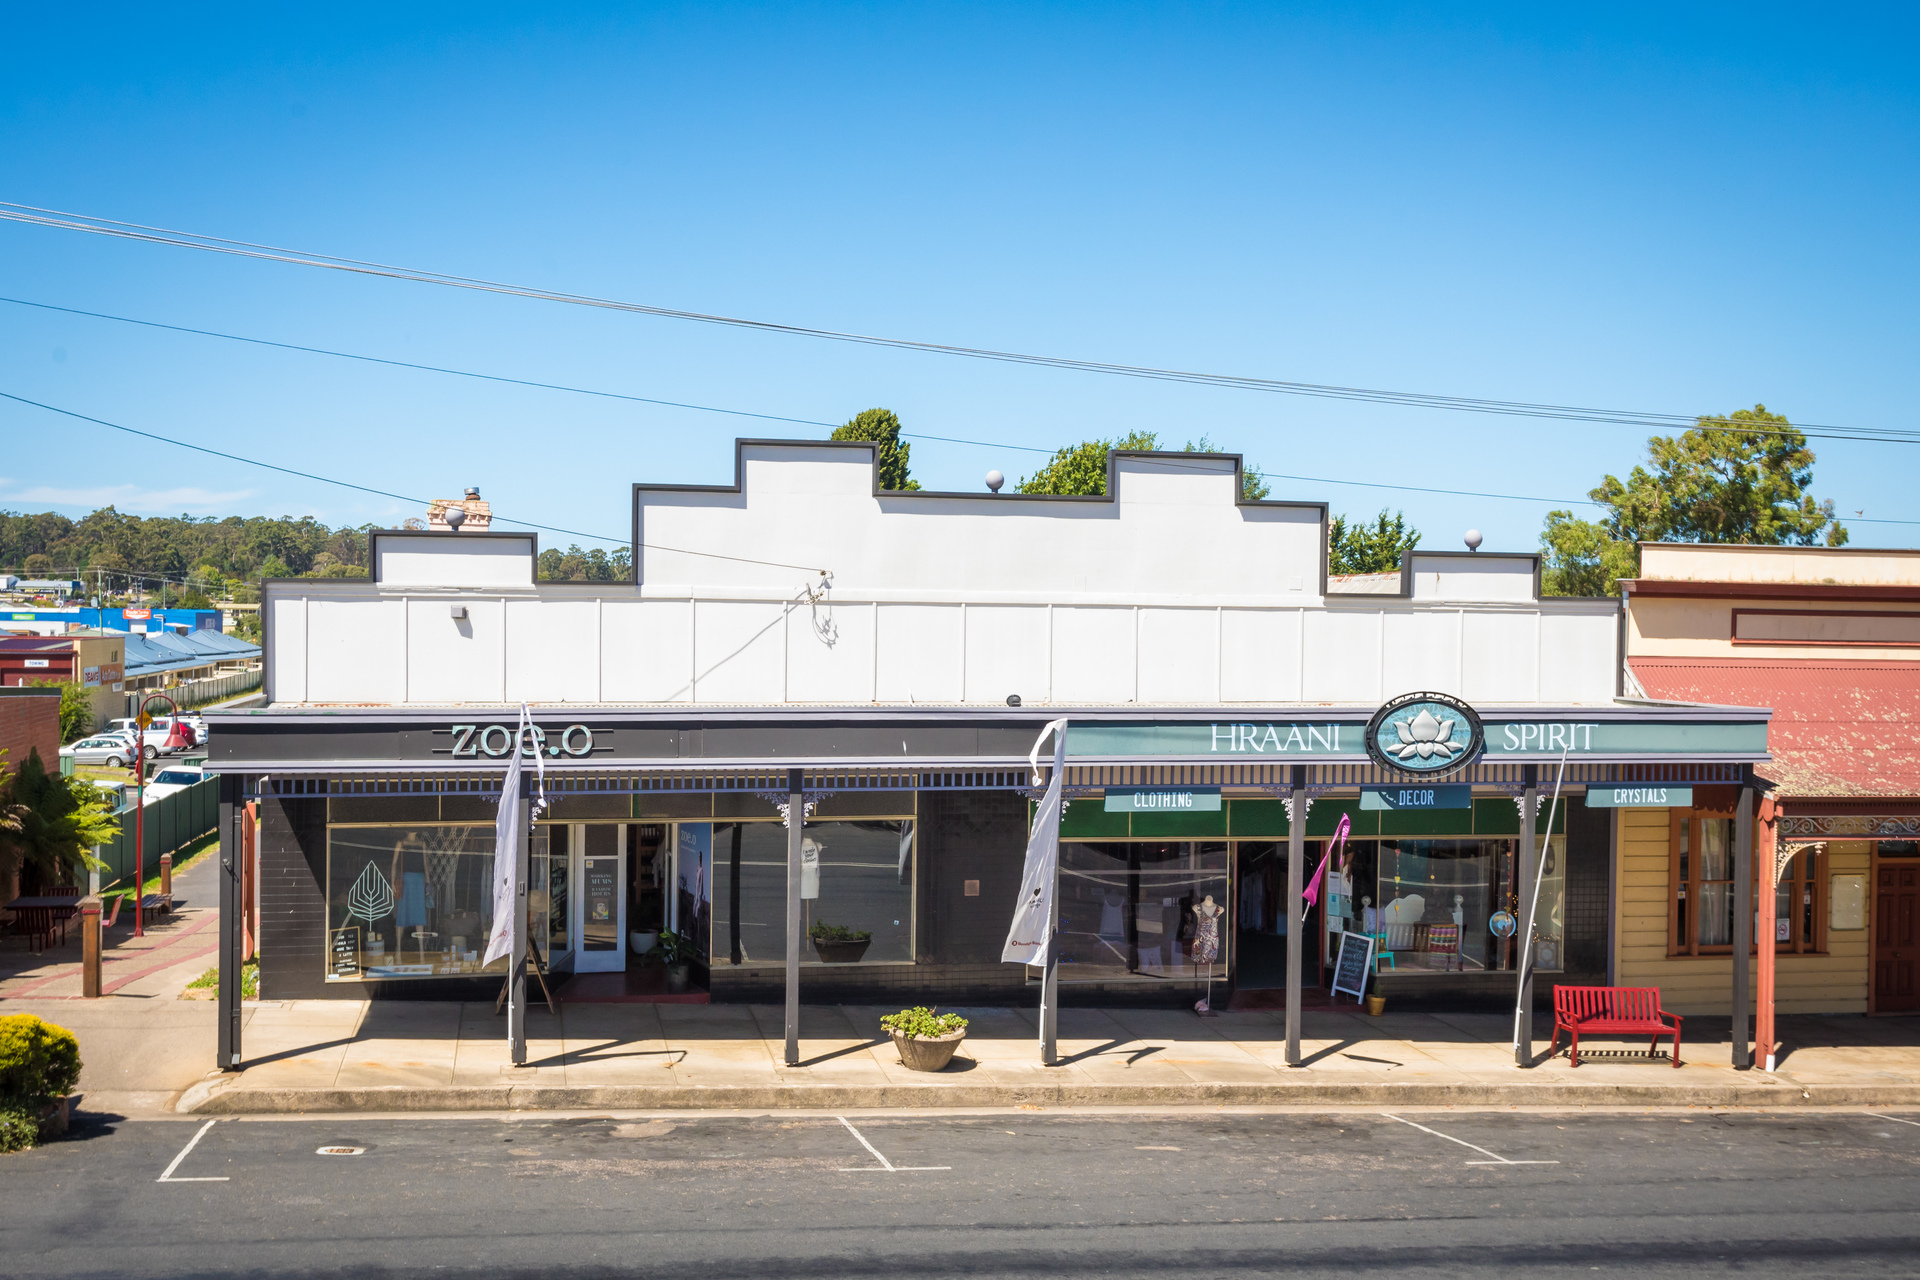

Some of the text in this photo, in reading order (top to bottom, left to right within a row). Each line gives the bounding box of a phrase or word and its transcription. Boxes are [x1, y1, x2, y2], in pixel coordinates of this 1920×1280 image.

[1210, 723, 1599, 752] HRAANI SPIRIT
[1133, 791, 1193, 808] CLOTHING
[1399, 789, 1435, 806] DECOR
[1613, 788, 1667, 804] CRYSTALS
[680, 830, 697, 845] zoe.o
